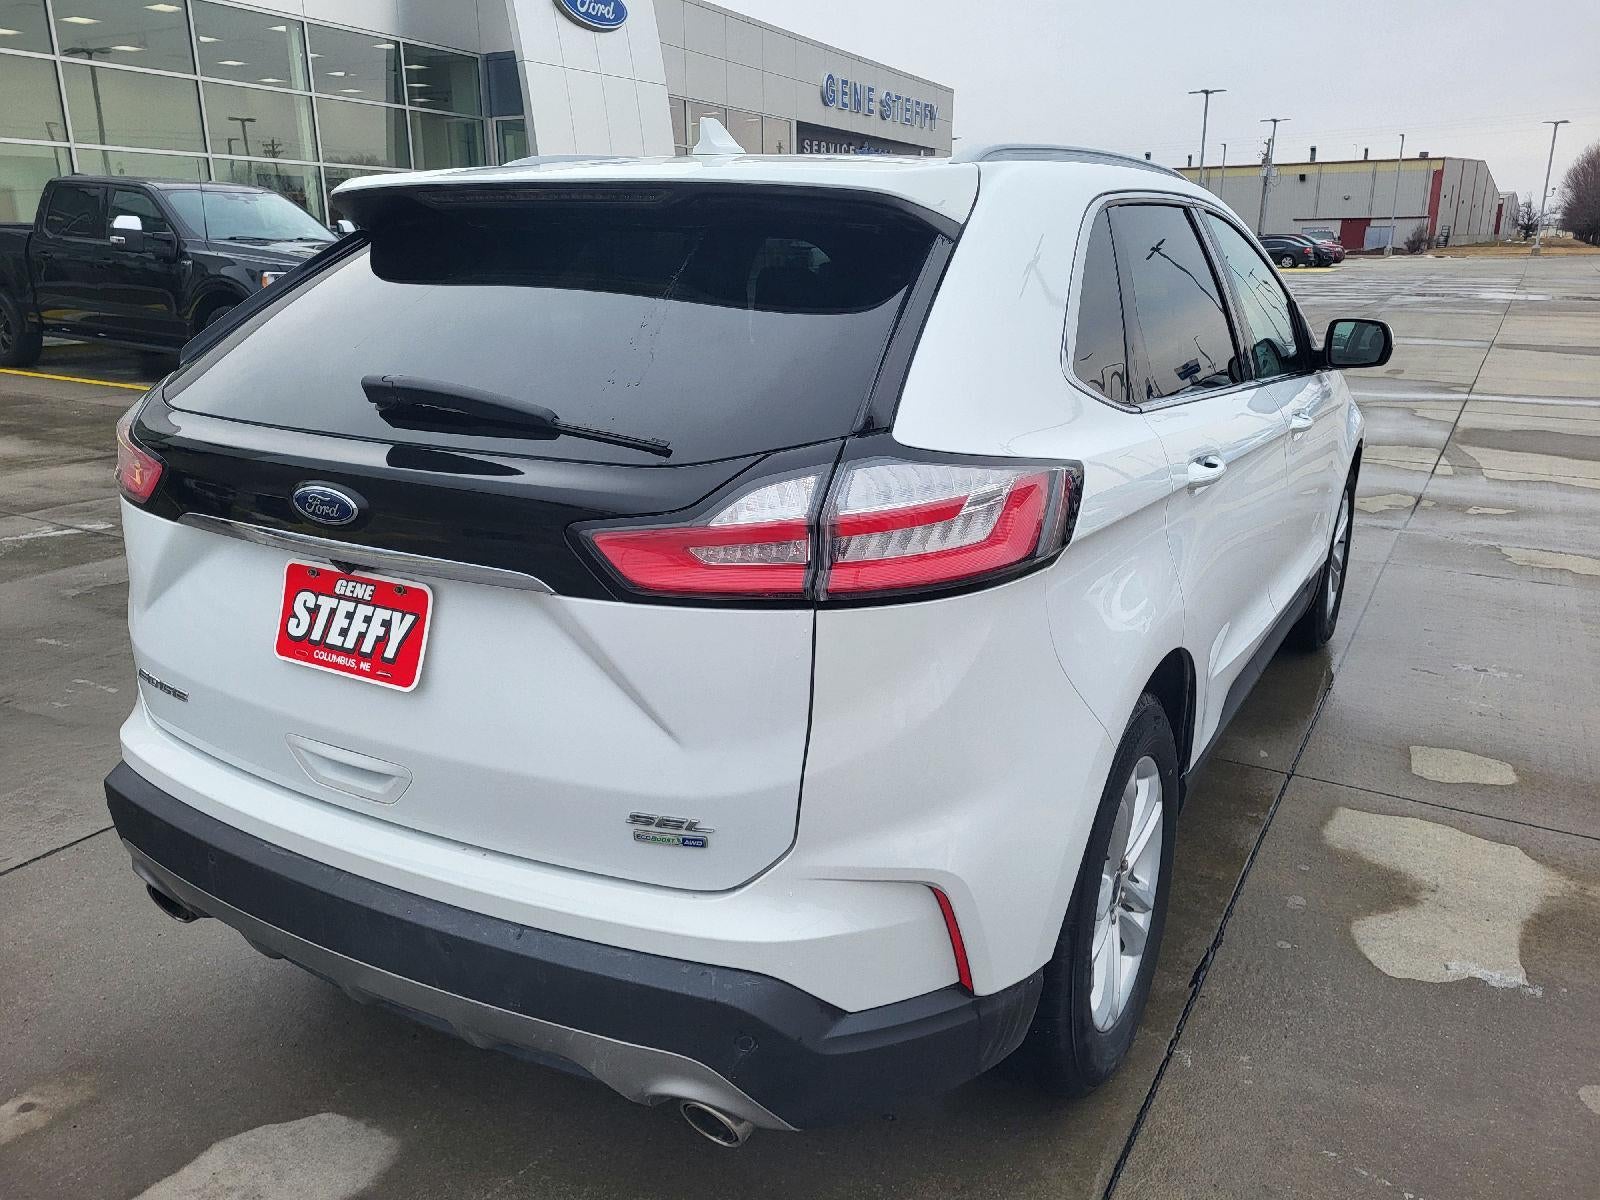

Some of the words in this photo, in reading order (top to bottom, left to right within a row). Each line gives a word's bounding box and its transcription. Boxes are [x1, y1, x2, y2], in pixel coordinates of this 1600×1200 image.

[821, 72, 876, 116] GENE
[880, 89, 939, 131] STEFFY
[803, 139, 856, 155] SERVICE
[305, 493, 340, 518] Ford
[333, 578, 376, 601] GENE
[286, 589, 420, 664] STEFFY
[313, 649, 358, 670] COLUMBUS,
[359, 661, 372, 672] NE
[625, 811, 714, 833] SEL
[683, 839, 703, 847] AWD
